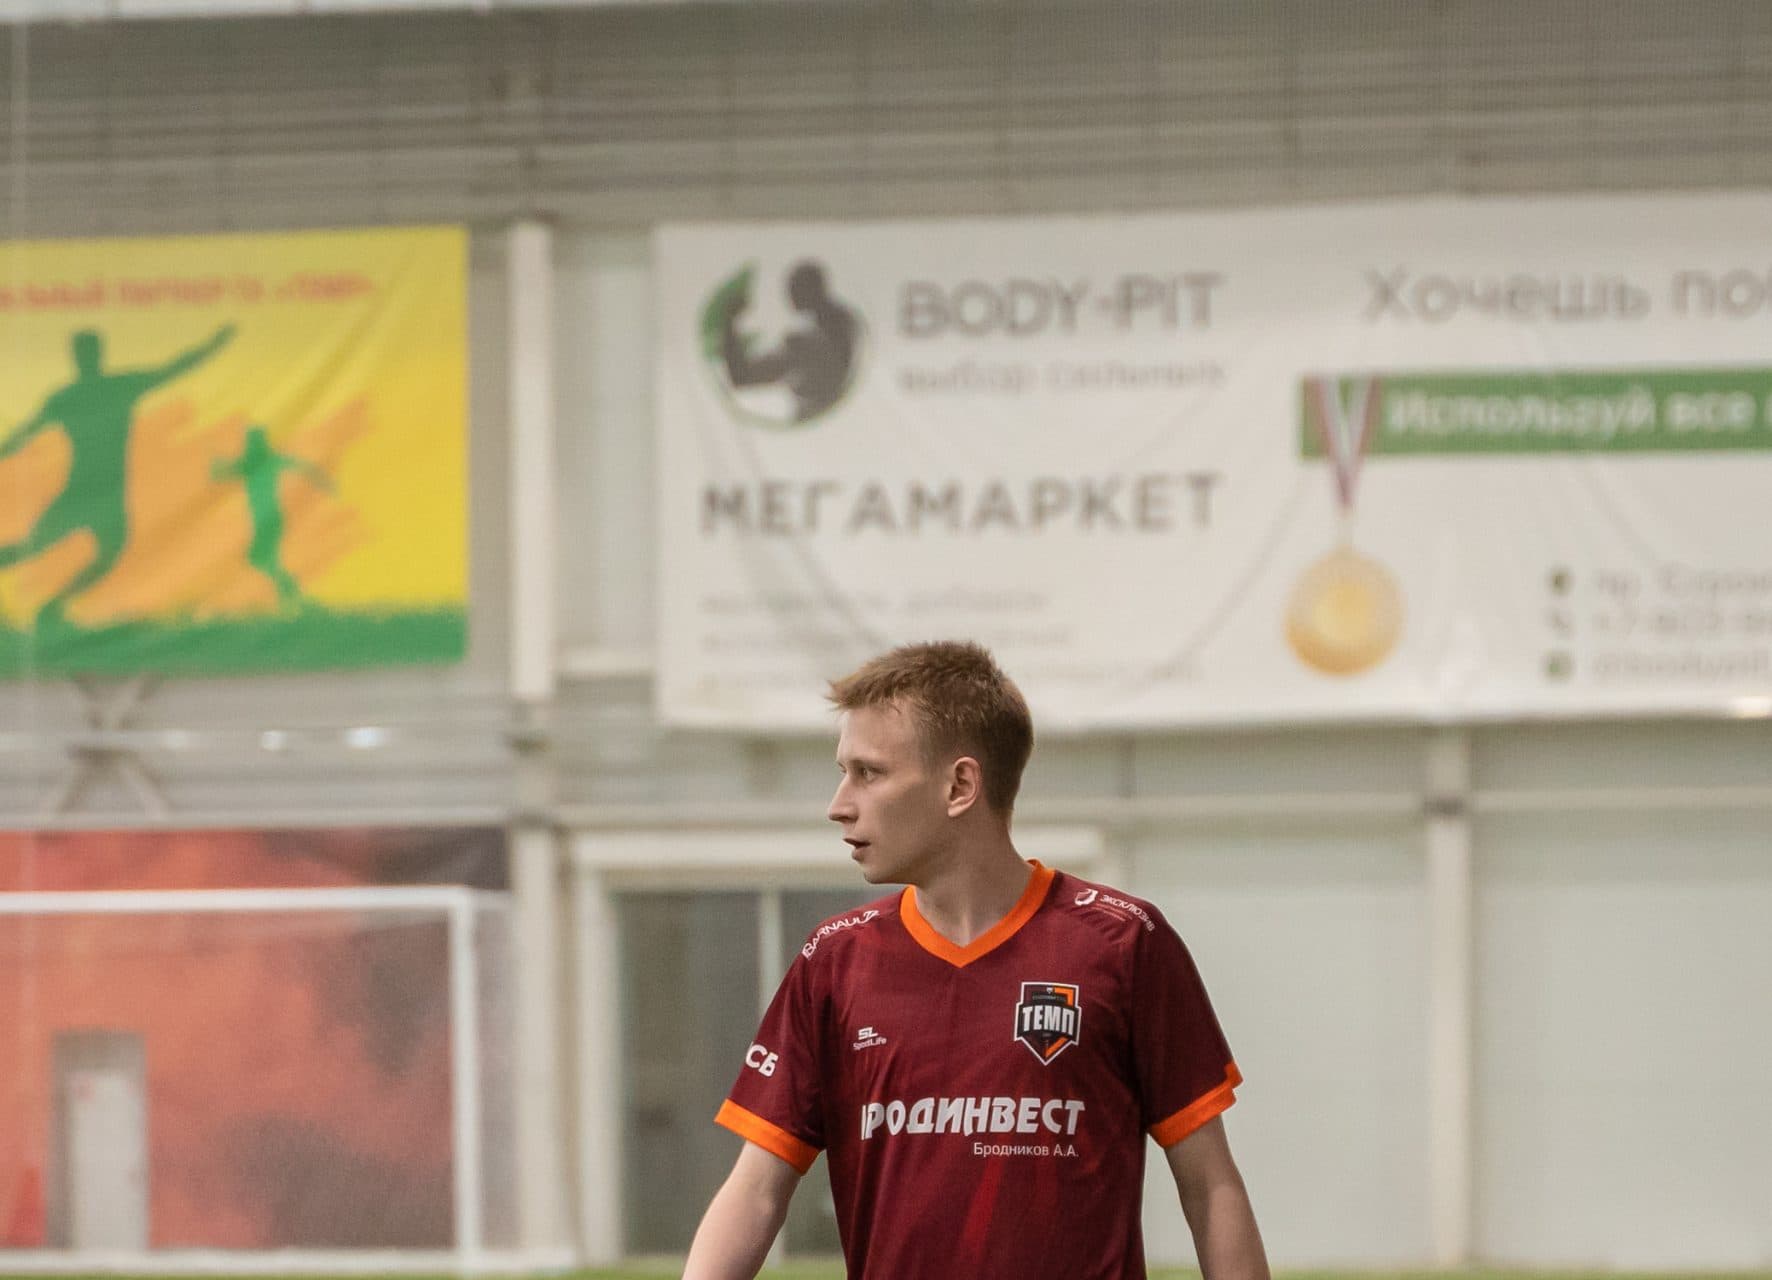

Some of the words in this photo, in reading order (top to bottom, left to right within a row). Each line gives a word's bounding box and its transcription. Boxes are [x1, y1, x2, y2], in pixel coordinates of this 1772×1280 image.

[900, 272, 1224, 338] BODY-PIT
[1361, 266, 1651, 323] Хочешь
[1670, 268, 1772, 320] по
[1387, 384, 1657, 440] Используй
[701, 473, 1224, 538] МЕГАМАРКЕТ
[1022, 1005, 1075, 1036] ТЕМП
[745, 1041, 779, 1077] СБ
[861, 1096, 1085, 1140] РОДИНВЕСТ
[974, 1142, 1049, 1157] Бродников
